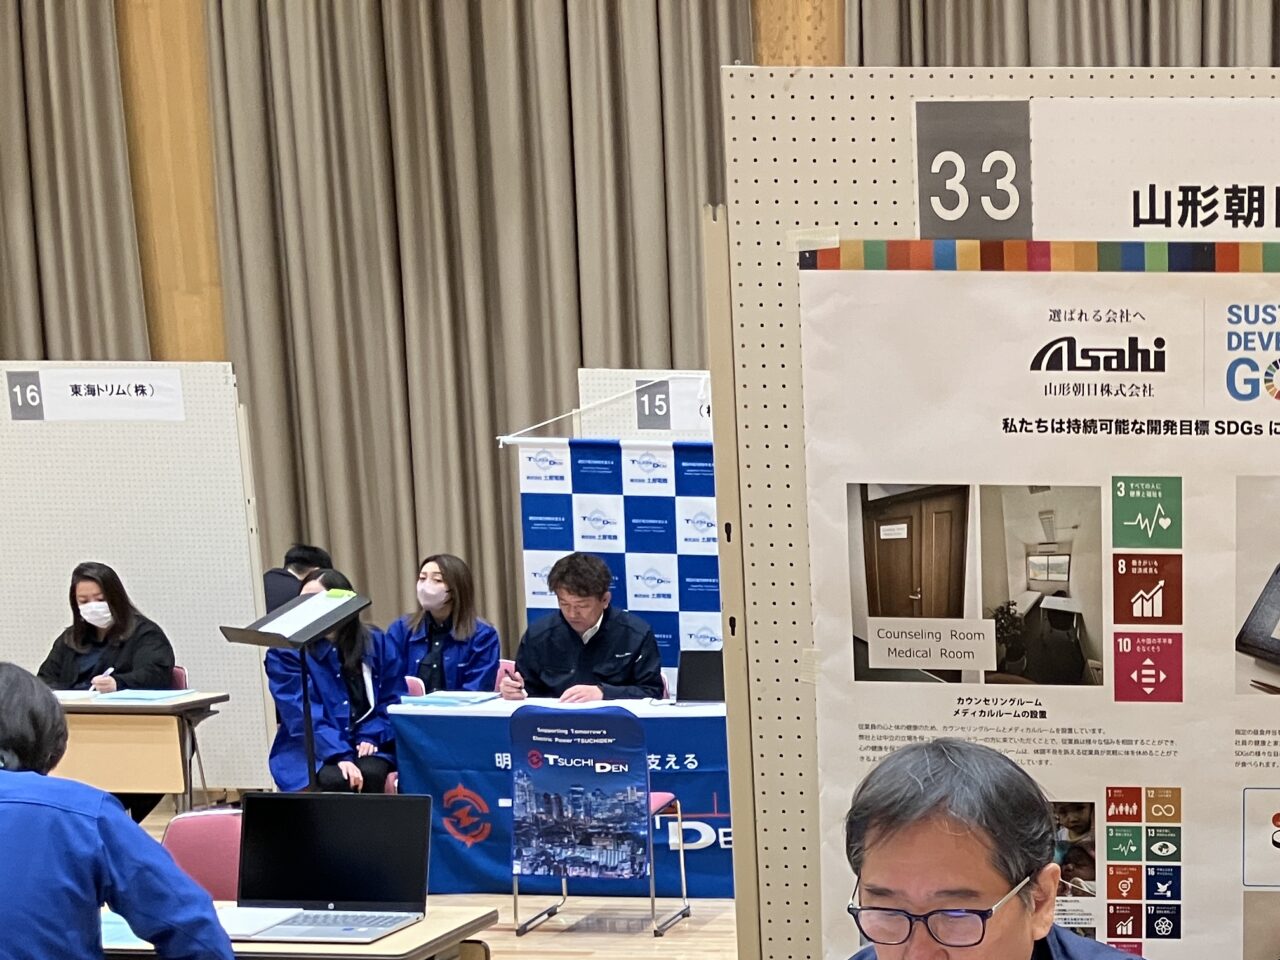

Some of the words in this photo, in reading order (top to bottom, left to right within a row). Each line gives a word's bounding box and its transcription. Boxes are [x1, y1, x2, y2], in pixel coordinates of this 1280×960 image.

[930, 151, 1020, 221] 33
[1048, 308, 1146, 323] 選ばれる会社へ
[1029, 336, 1167, 373] Asahi
[12, 384, 40, 406] 16
[69, 384, 155, 397] 東海トリム（株）
[1044, 382, 1155, 398] 山形朝日株式会社
[640, 394, 667, 416] 15
[1117, 481, 1125, 497] 3
[1118, 559, 1126, 574] 8
[877, 628, 942, 642] Counseling
[950, 630, 985, 640] Room
[1117, 637, 1132, 653] 10
[887, 648, 932, 658] Medical
[940, 648, 974, 659] Room
[957, 697, 1042, 706] カウンセリングルーム
[953, 709, 1047, 719] メディカルルームの設置
[495, 752, 512, 769] 明
[668, 821, 732, 850] DE
